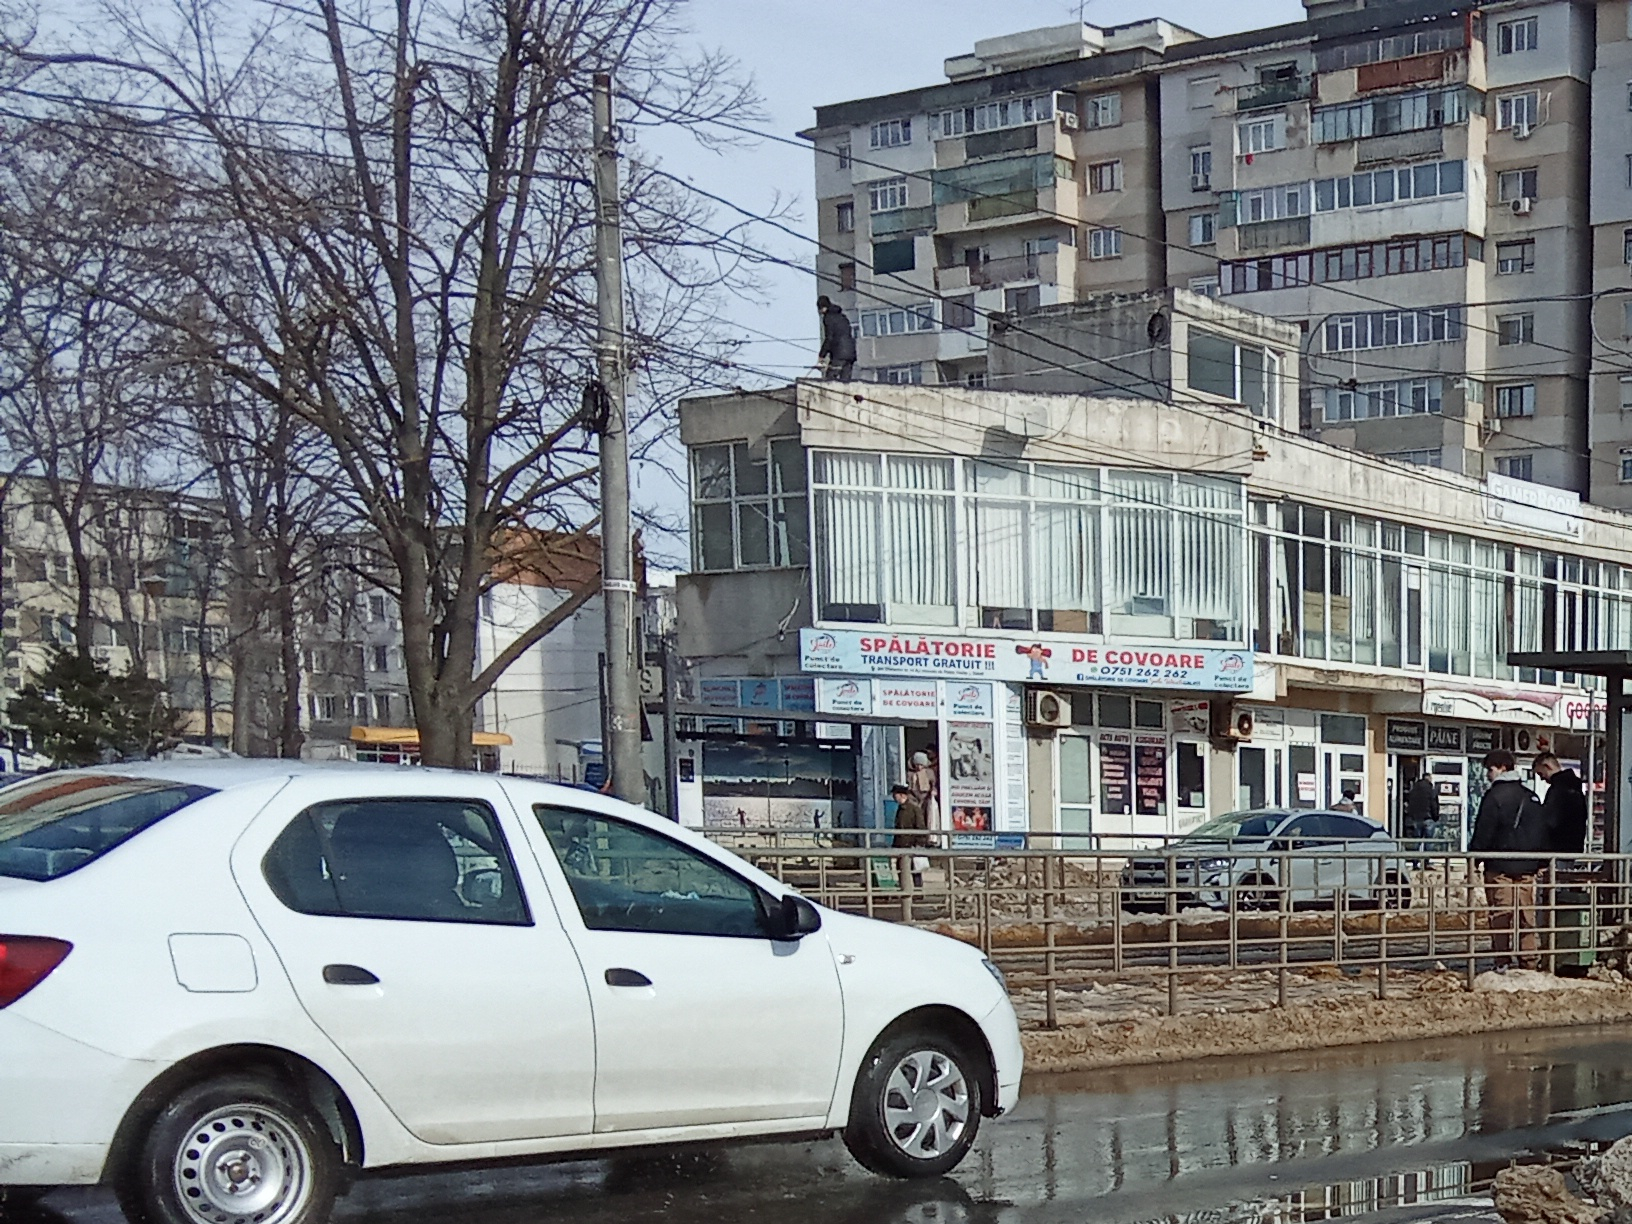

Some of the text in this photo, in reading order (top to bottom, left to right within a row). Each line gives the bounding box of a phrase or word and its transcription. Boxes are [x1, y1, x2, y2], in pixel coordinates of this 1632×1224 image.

[859, 636, 996, 659] SPĂLĂTORIE
[861, 654, 995, 670] TRANSPORT GRATUIT !!!
[1072, 649, 1205, 669] DE COVOARE
[1100, 666, 1188, 678] 0751 262 262
[882, 689, 936, 698] SPĂLĂTORIE
